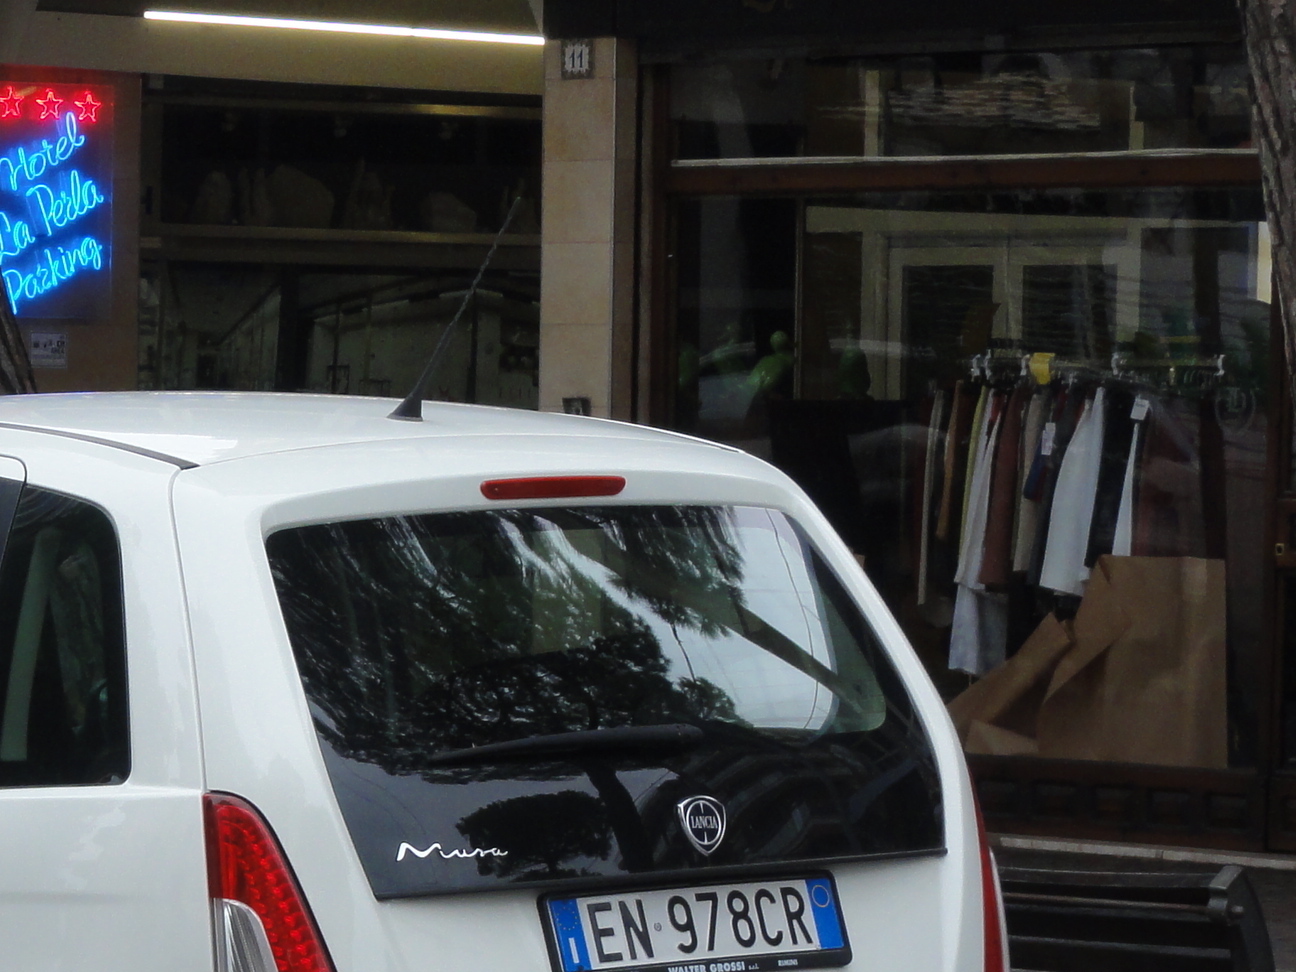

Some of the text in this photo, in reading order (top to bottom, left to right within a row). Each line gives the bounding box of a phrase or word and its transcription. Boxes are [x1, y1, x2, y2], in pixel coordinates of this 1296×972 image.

[568, 48, 584, 69] 11
[26, 169, 104, 237] Perla
[2, 237, 103, 315] Parking
[690, 815, 719, 829] LANCIA
[395, 841, 509, 862] Musa
[587, 898, 655, 964] EN
[667, 886, 814, 954] 978CR
